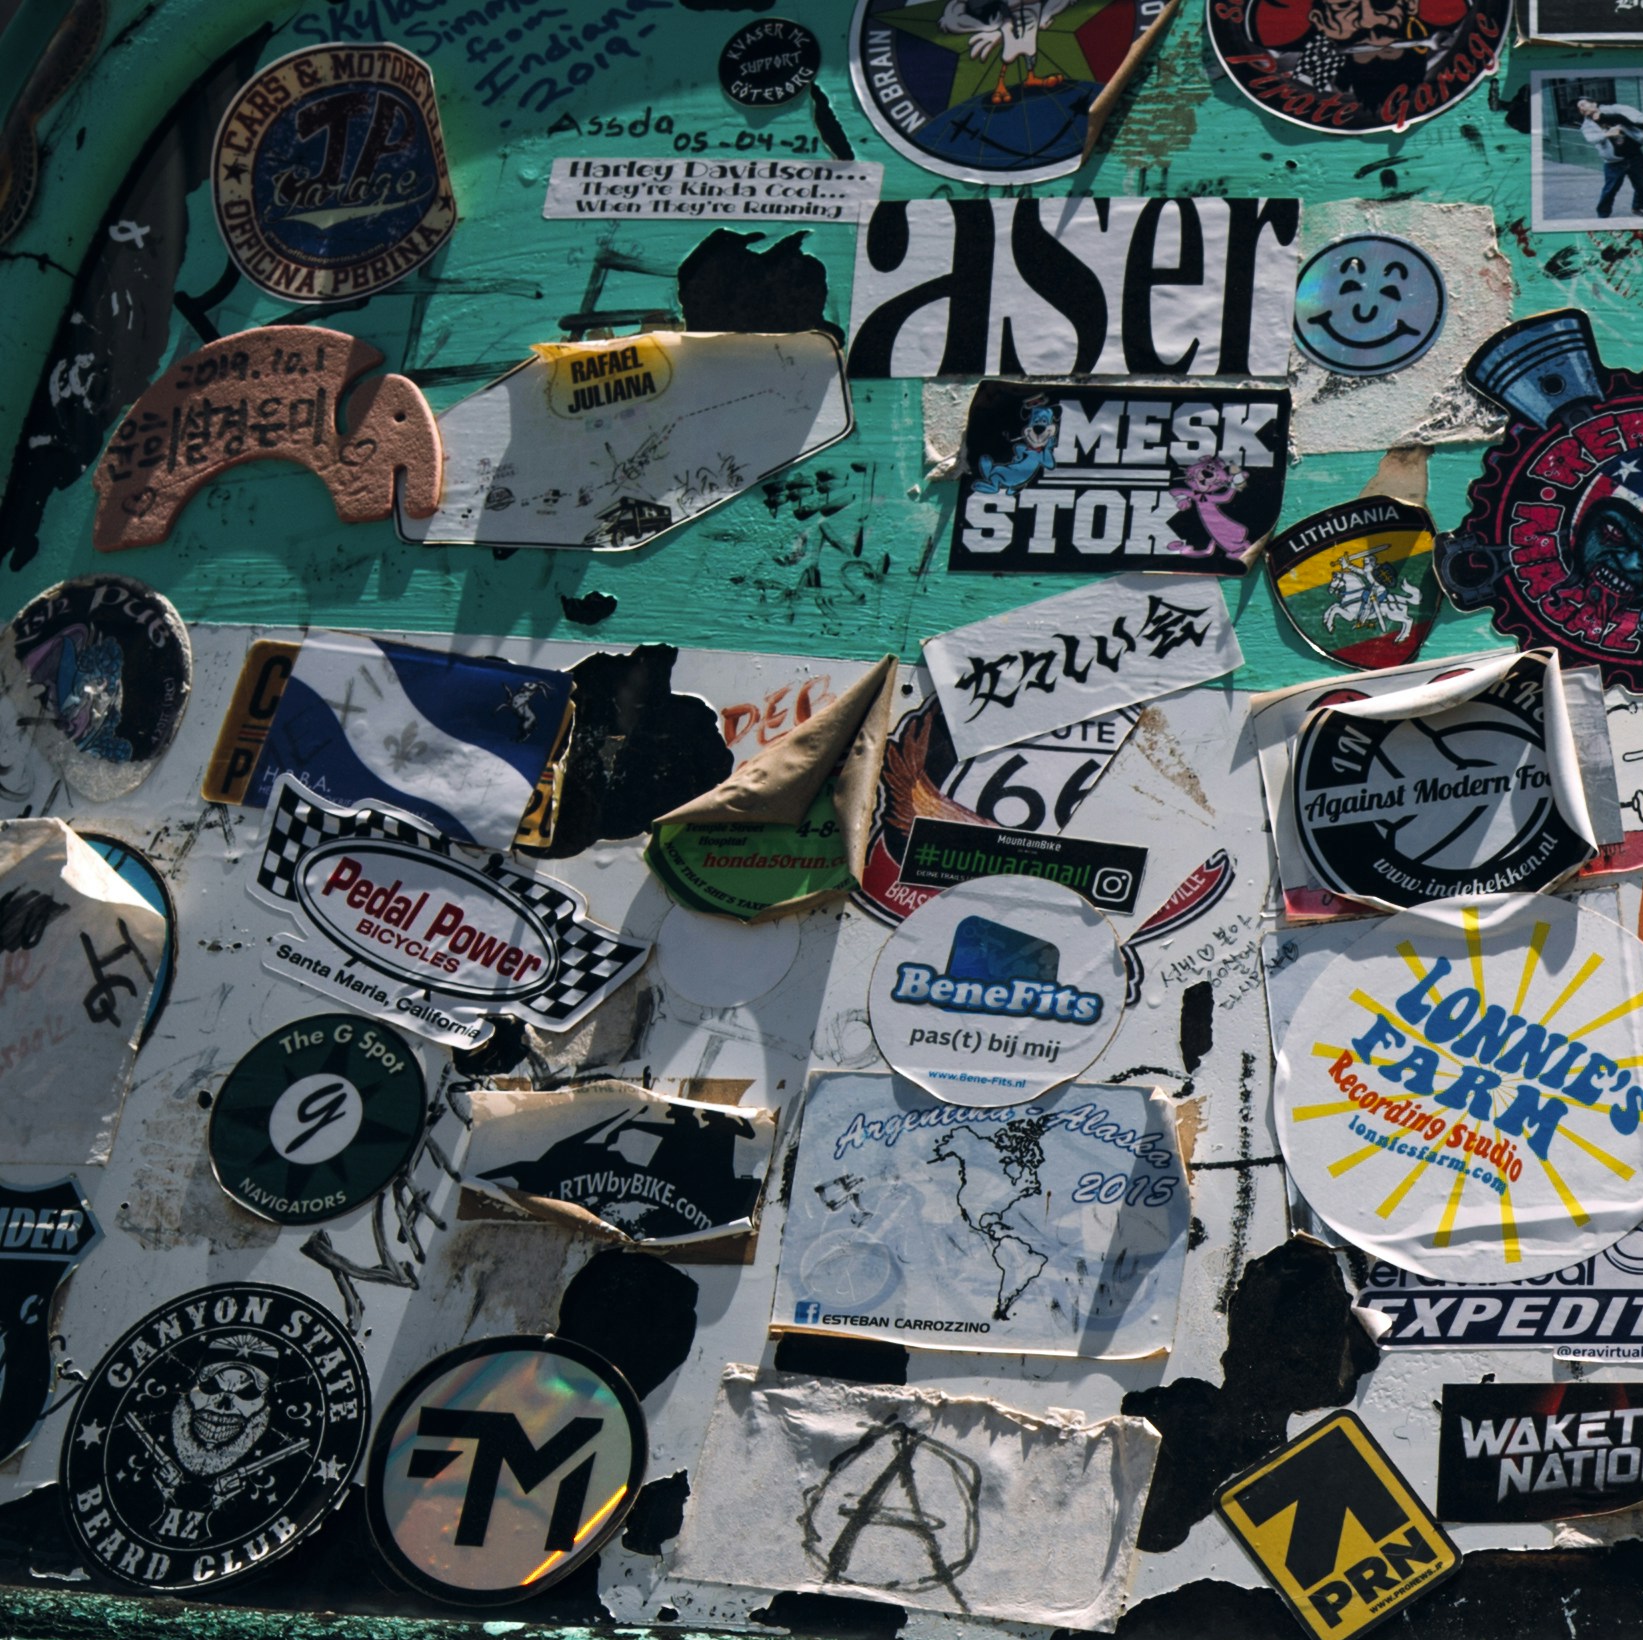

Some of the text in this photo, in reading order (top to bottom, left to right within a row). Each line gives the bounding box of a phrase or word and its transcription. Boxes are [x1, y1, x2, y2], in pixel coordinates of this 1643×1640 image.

[568, 161, 867, 181] Harley Davidson...
[581, 181, 846, 198] They're Kinda Cool...
[575, 199, 842, 218] When They're Running
[846, 199, 1299, 377] aser
[570, 347, 644, 385] RAFAEL
[568, 373, 656, 413] JULIANA
[1057, 402, 1275, 466] MESK
[1306, 772, 1510, 824] Against Modern
[322, 857, 543, 982] Pedal Power
[355, 919, 460, 976] BICYCLES
[276, 943, 481, 1043] Santa Maria, California
[895, 965, 1099, 1025] BeneFits
[910, 1027, 1060, 1063] pas(t) bij mij
[927, 1070, 1027, 1090] www.Bene-Fits.nl
[1351, 1014, 1575, 1161] FARM
[835, 1105, 1173, 1170] Argentina Alaska
[239, 1176, 347, 1215] NAVIGATORS
[558, 1173, 715, 1231] RTWbyBIKE.com
[1074, 1172, 1176, 1206] 2015
[822, 1312, 991, 1334] ESTEBAN CARROZZINO
